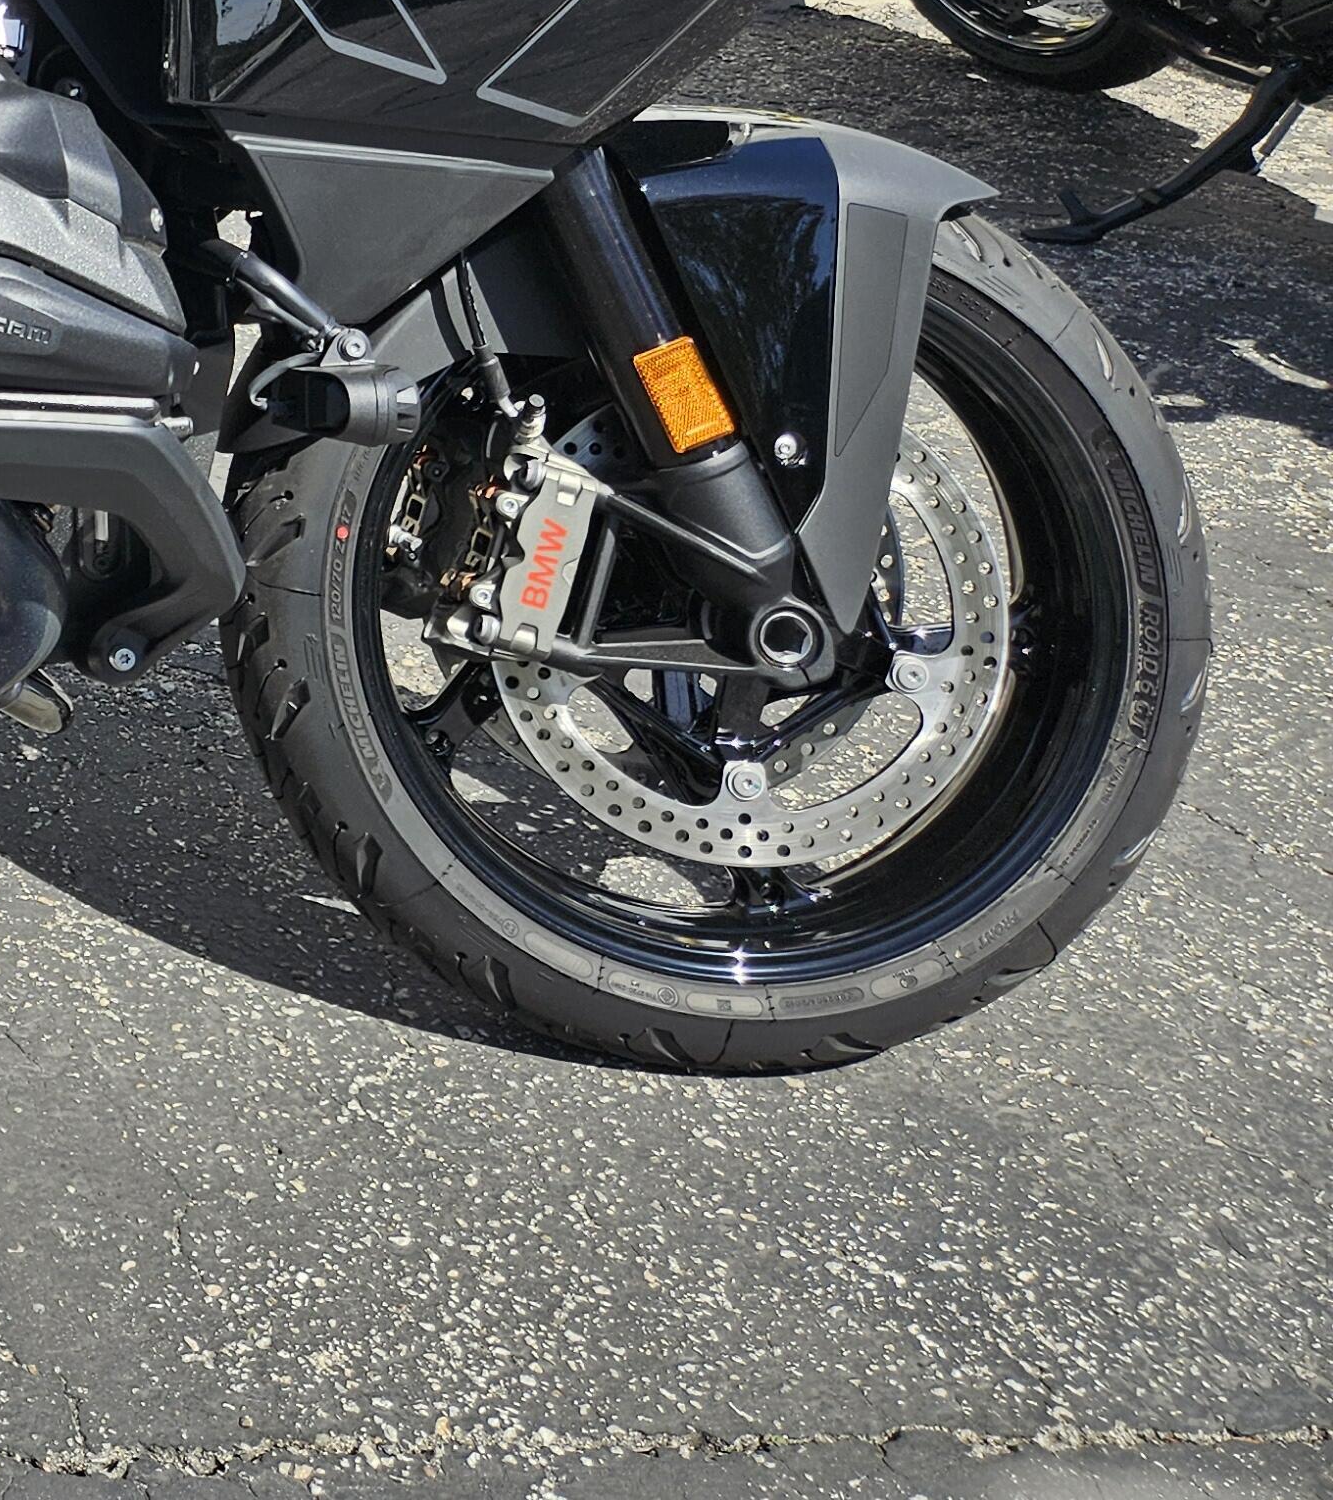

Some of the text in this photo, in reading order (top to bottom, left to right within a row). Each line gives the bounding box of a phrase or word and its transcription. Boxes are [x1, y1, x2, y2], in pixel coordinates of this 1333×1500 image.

[331, 561, 344, 622] 120/70
[519, 518, 568, 610] BMW
[1107, 466, 1162, 740] MICHELIN ROAD 6 GT
[333, 640, 378, 760] MICHELIN
